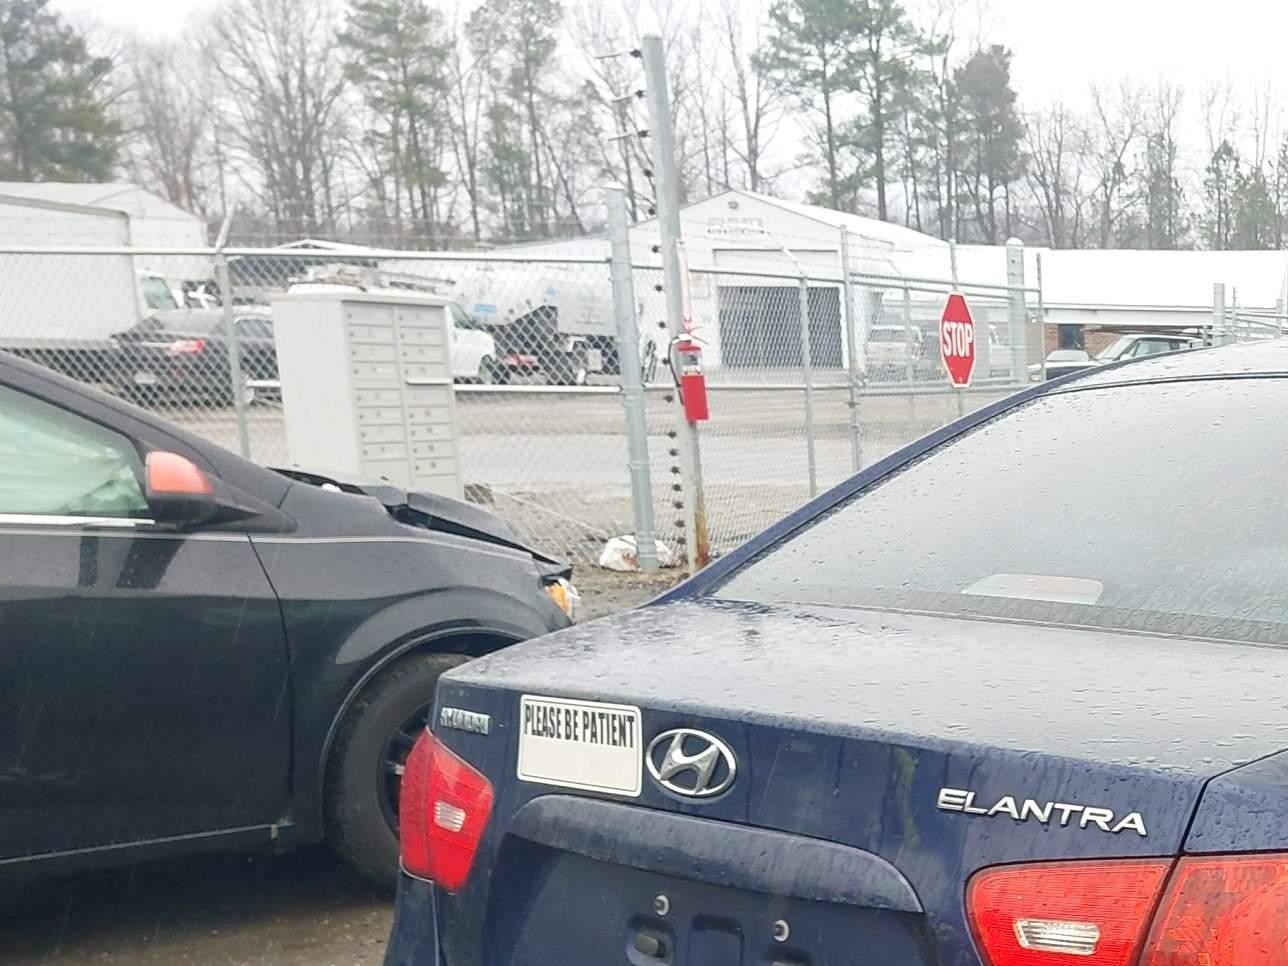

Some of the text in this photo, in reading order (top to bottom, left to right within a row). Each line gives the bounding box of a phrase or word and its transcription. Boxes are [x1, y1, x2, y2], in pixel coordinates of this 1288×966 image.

[942, 320, 973, 358] STOP
[524, 703, 562, 740] PLEASE
[564, 708, 579, 741] BE
[582, 711, 635, 748] PATIENT
[936, 787, 1147, 836] ELANTRA
